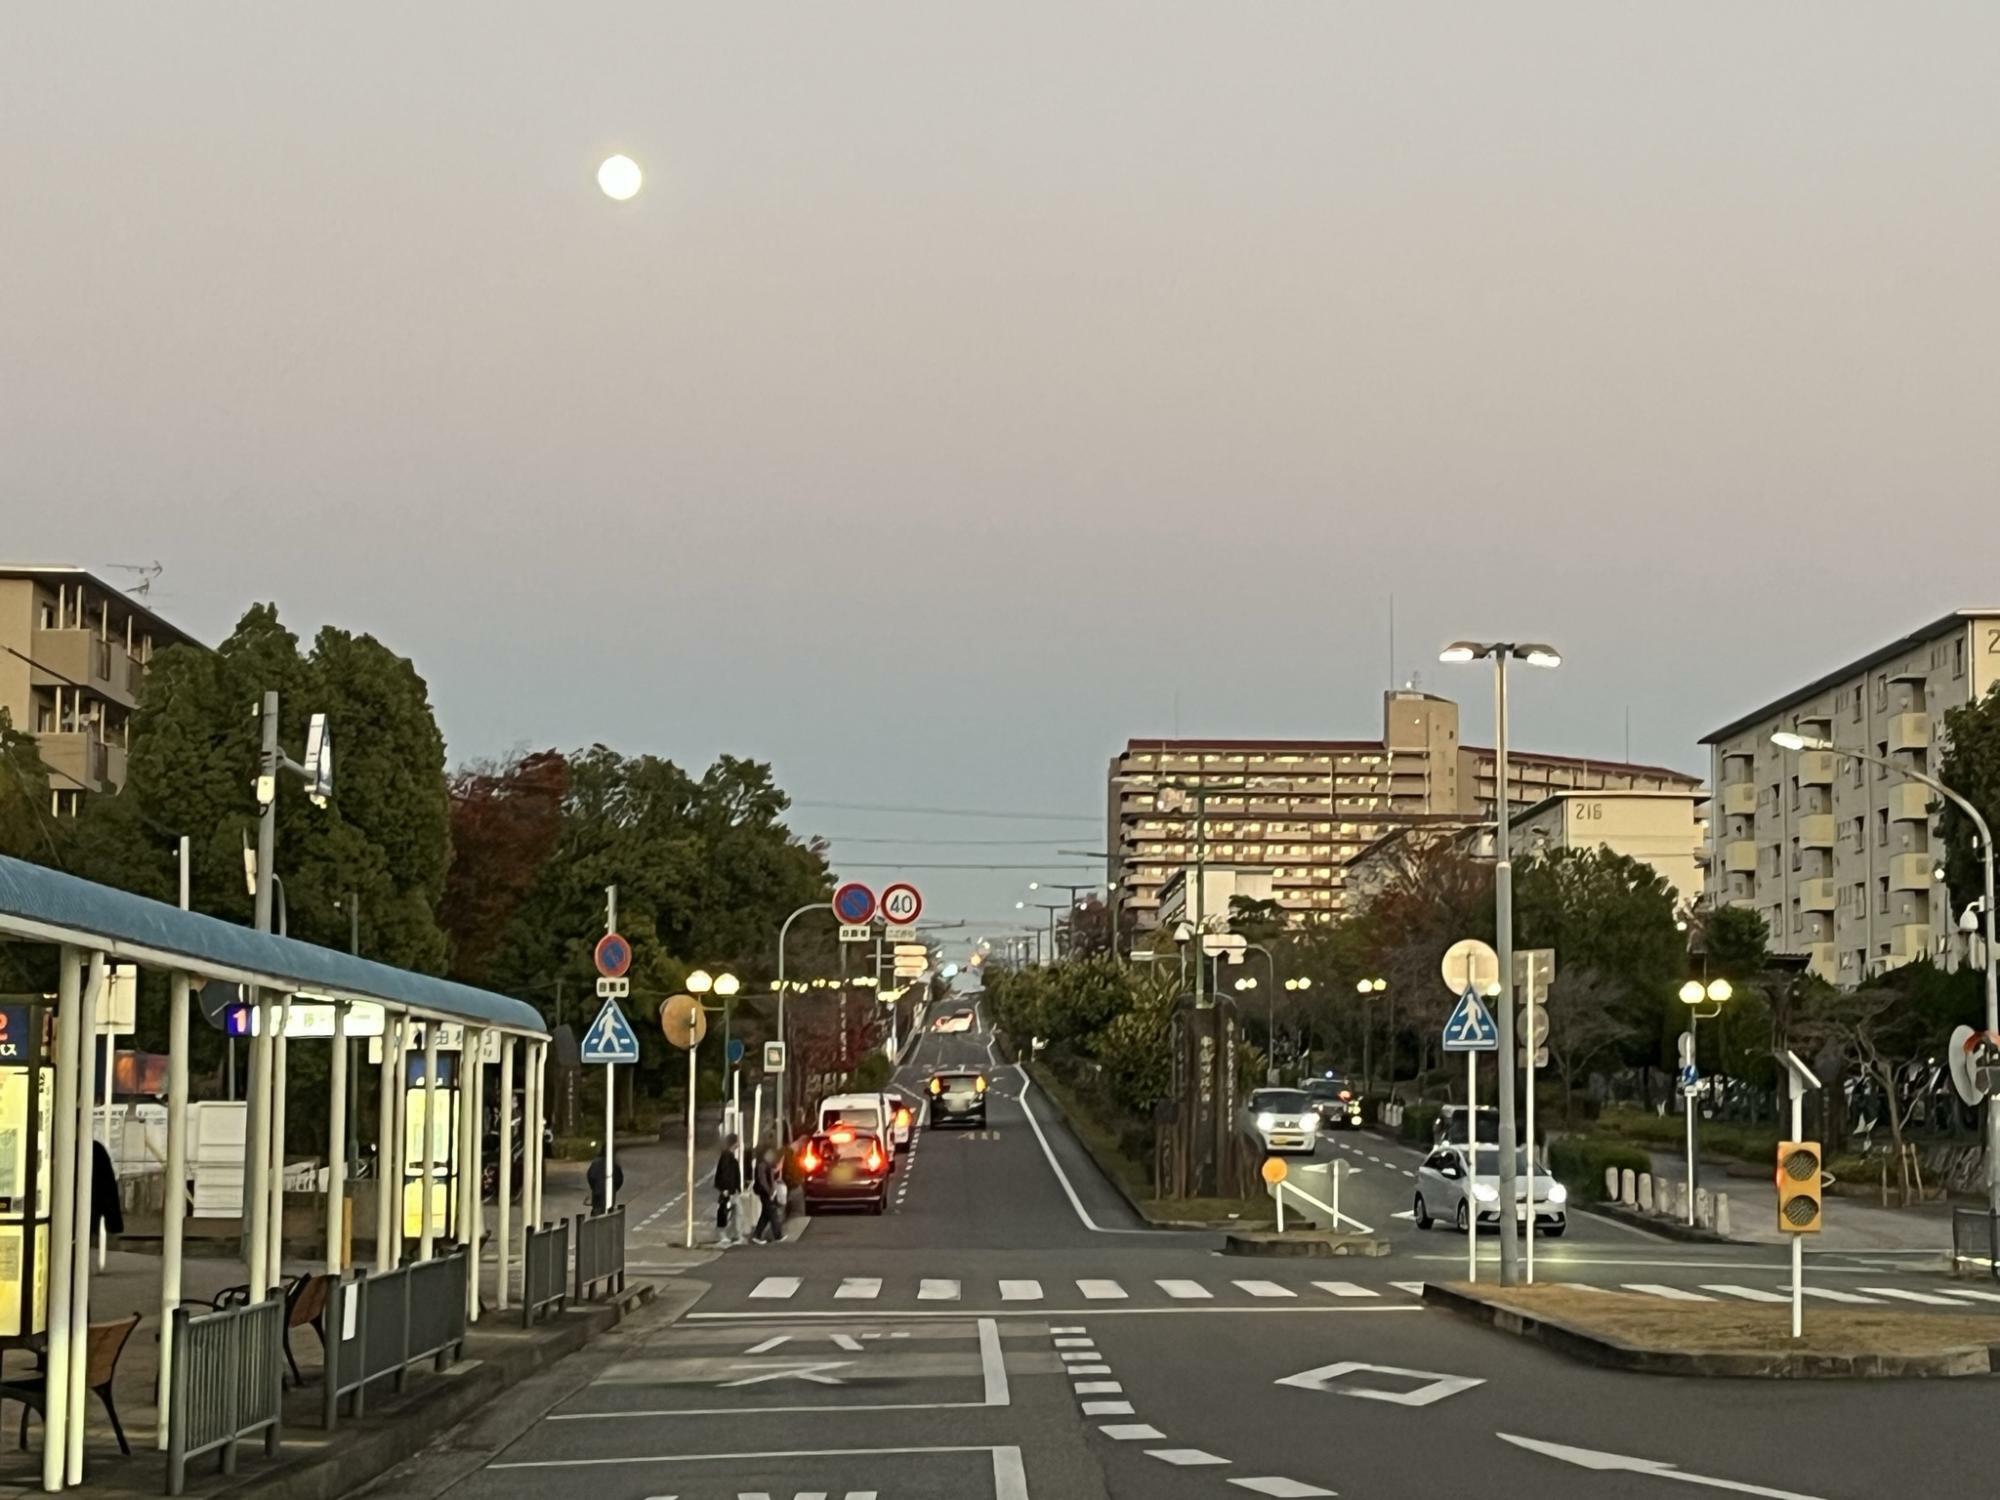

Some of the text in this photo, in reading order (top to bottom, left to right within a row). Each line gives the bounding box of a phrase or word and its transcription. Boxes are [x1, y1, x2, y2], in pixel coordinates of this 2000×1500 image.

[1576, 803, 1602, 820] 216
[890, 895, 913, 914] 40
[232, 1008, 247, 1033] 1
